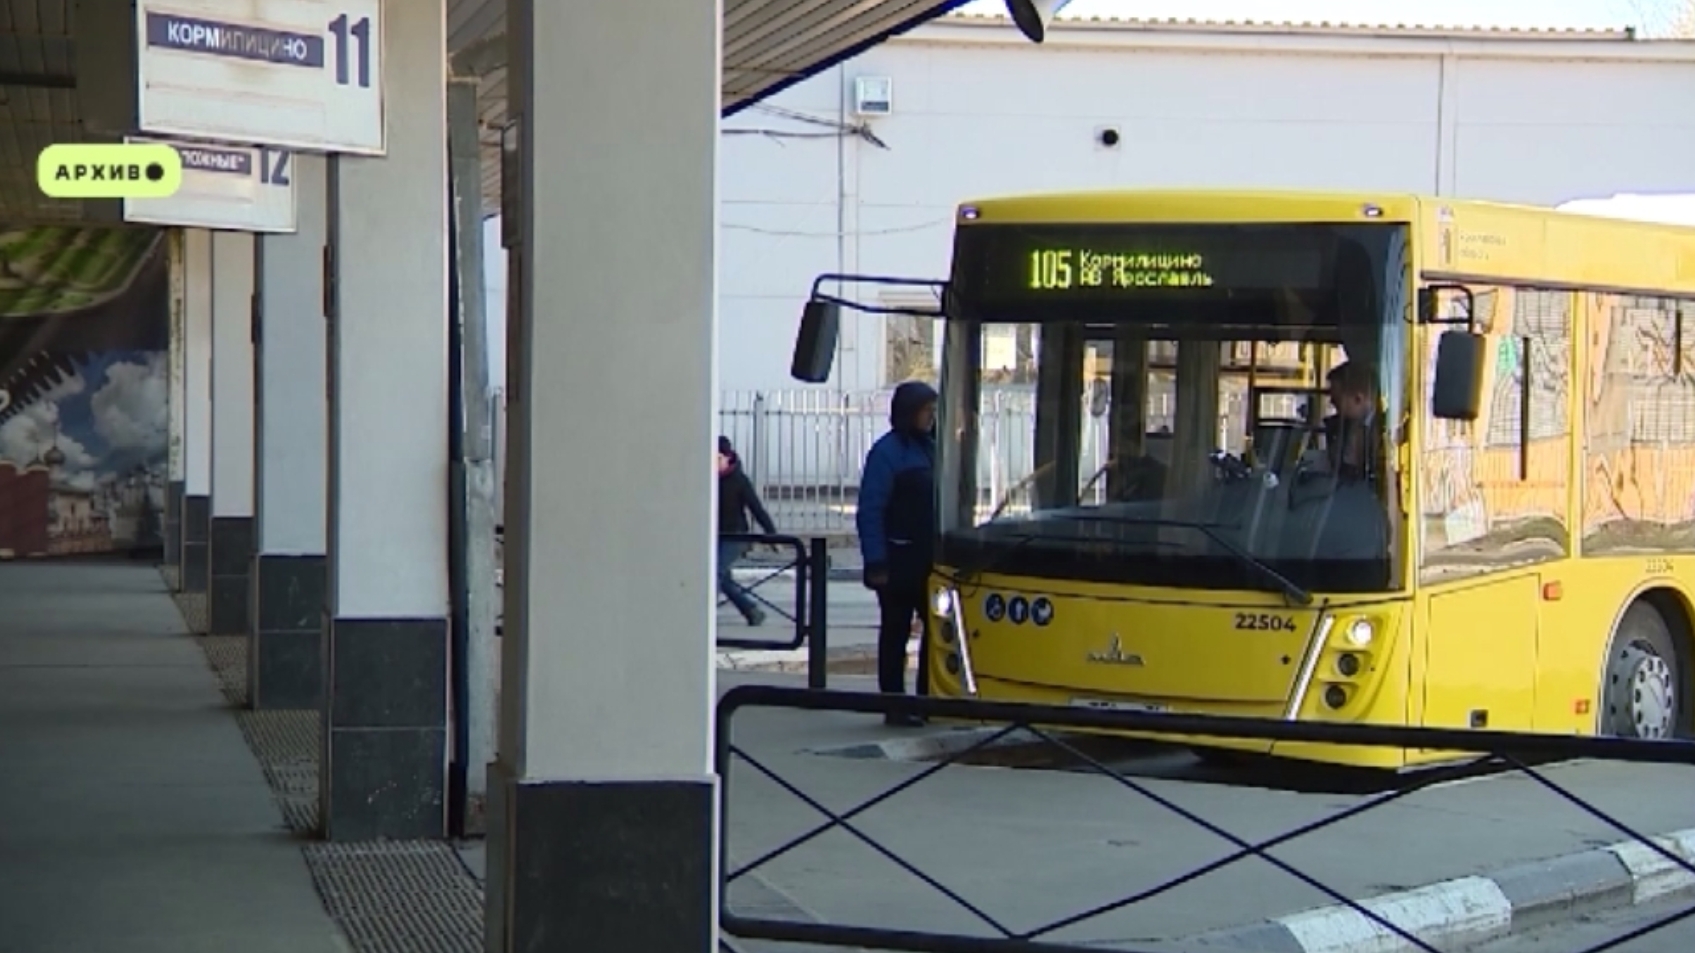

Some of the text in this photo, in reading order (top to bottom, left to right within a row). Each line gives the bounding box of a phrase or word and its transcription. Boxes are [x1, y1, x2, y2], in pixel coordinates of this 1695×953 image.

[167, 20, 308, 60] КОРМИЛИЦИНО
[328, 13, 371, 88] 11
[259, 150, 290, 185] 12
[1029, 249, 1072, 289] 105
[1079, 249, 1203, 269] Кормилицино
[1079, 268, 1214, 288] АВ Ярославль
[1235, 612, 1297, 632] 22504
